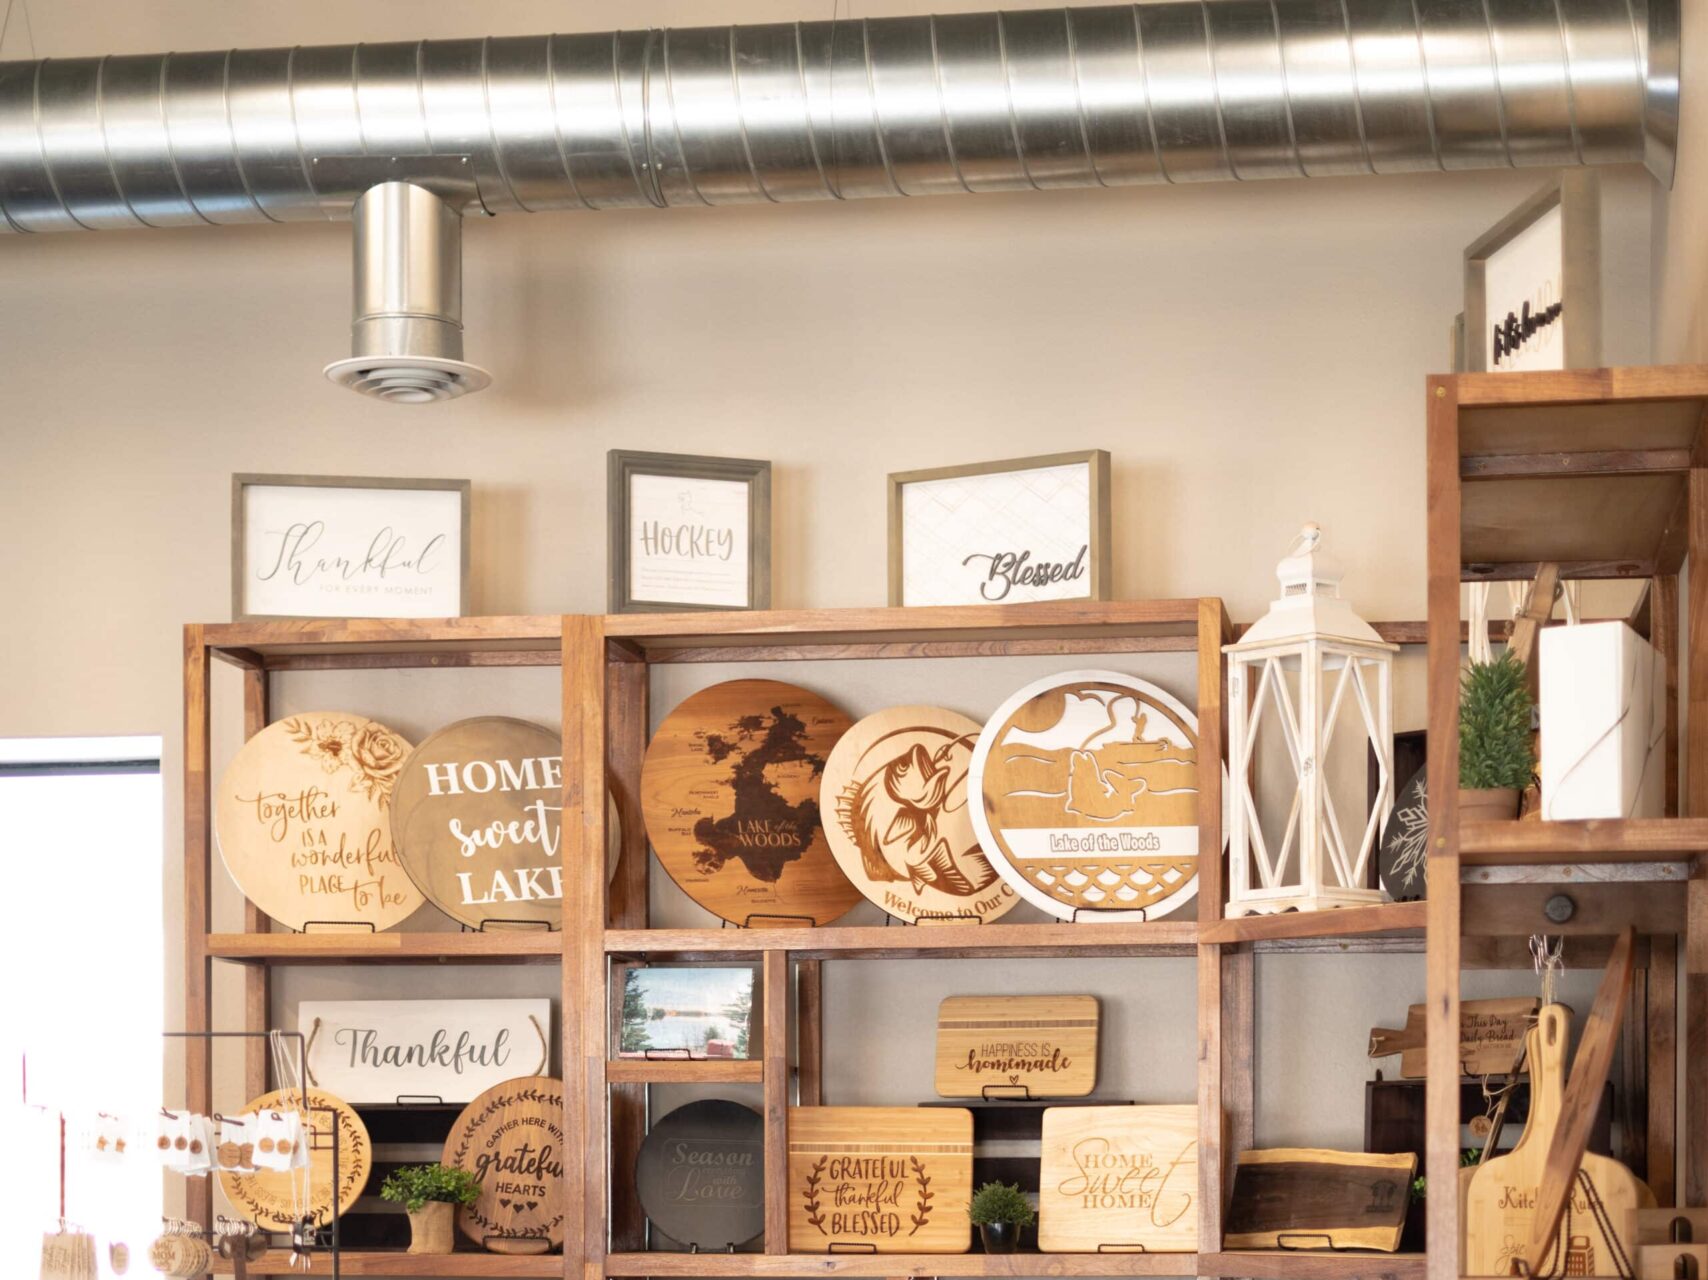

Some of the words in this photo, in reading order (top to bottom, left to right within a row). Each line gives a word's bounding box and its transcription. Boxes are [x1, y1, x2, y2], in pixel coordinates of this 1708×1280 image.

[256, 521, 446, 585] Thankful
[640, 520, 733, 561] HOCKEY
[962, 544, 1088, 601] Blessed
[384, 586, 433, 596] MOMENT
[424, 756, 562, 795] HOME
[235, 786, 340, 842] together
[449, 799, 562, 857] sweet
[737, 820, 770, 833] LAKE
[302, 829, 313, 846] IS
[318, 829, 327, 846] A
[738, 832, 801, 847] WOODS
[1050, 833, 1079, 852] Lake
[1081, 833, 1095, 852] of
[1097, 833, 1119, 851] the
[1119, 832, 1160, 851] Woods
[300, 875, 345, 894] PLACE
[352, 880, 374, 911] to
[380, 876, 407, 909] be
[885, 891, 953, 921] Welcome
[957, 906, 972, 920] to
[974, 894, 1002, 915] Our
[334, 1028, 511, 1074] Thankful
[955, 1047, 1071, 1073] homemade
[981, 1042, 1038, 1057] HAPPINESS
[1041, 1042, 1051, 1057] IS
[486, 1119, 519, 1148] GATHER
[521, 1117, 547, 1128] HERE
[472, 1143, 563, 1184] gratefu
[672, 1143, 753, 1166] Season
[829, 1155, 910, 1180] GRATEFUL
[1084, 1154, 1153, 1169] HOME
[495, 1181, 546, 1197] HEARTS
[667, 1165, 745, 1201] Love
[821, 1180, 904, 1213] thankful
[1058, 1137, 1198, 1227] Sweet
[1083, 1194, 1151, 1209] HOME
[831, 1210, 900, 1237] BLESSED
